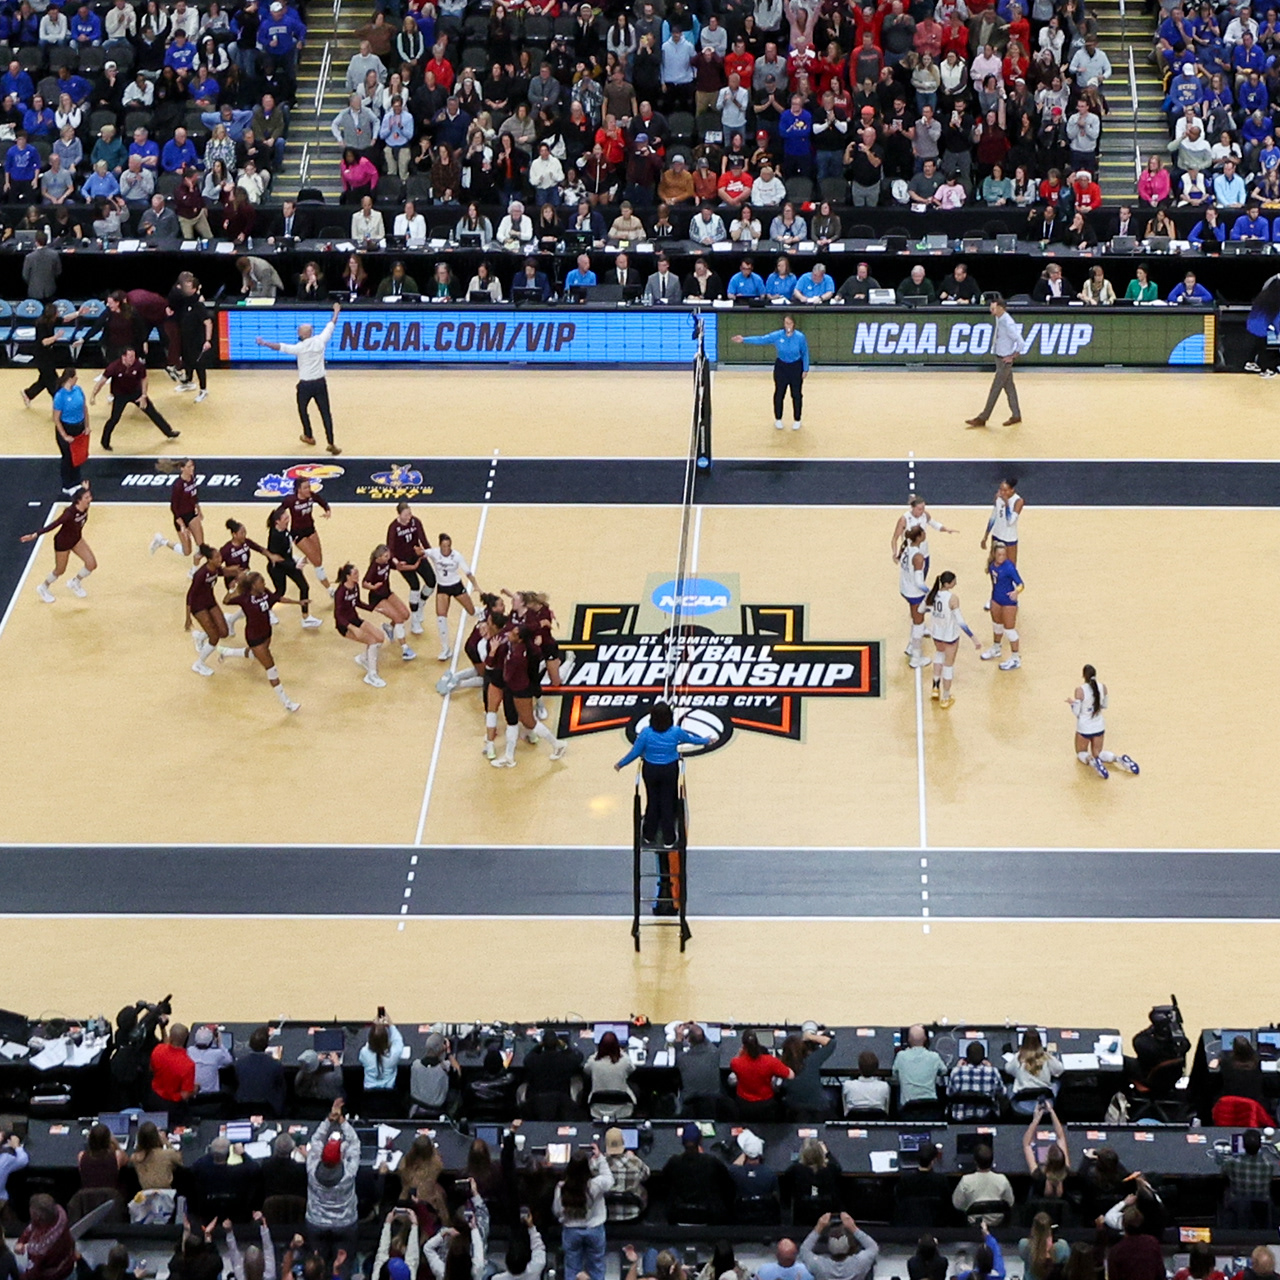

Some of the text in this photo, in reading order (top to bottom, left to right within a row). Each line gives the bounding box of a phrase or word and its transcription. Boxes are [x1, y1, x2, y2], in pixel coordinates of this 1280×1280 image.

[339, 321, 576, 352] NCAA.COM/VIP
[853, 322, 1094, 355] NCAA.CO/VIP
[121, 474, 242, 487] HOSTD BY:
[659, 595, 730, 608] NCAA
[663, 636, 734, 645] WOMEN'S
[596, 645, 775, 663] VOLLEYBALL
[586, 694, 638, 706] 2025
[733, 694, 777, 706] CITY
